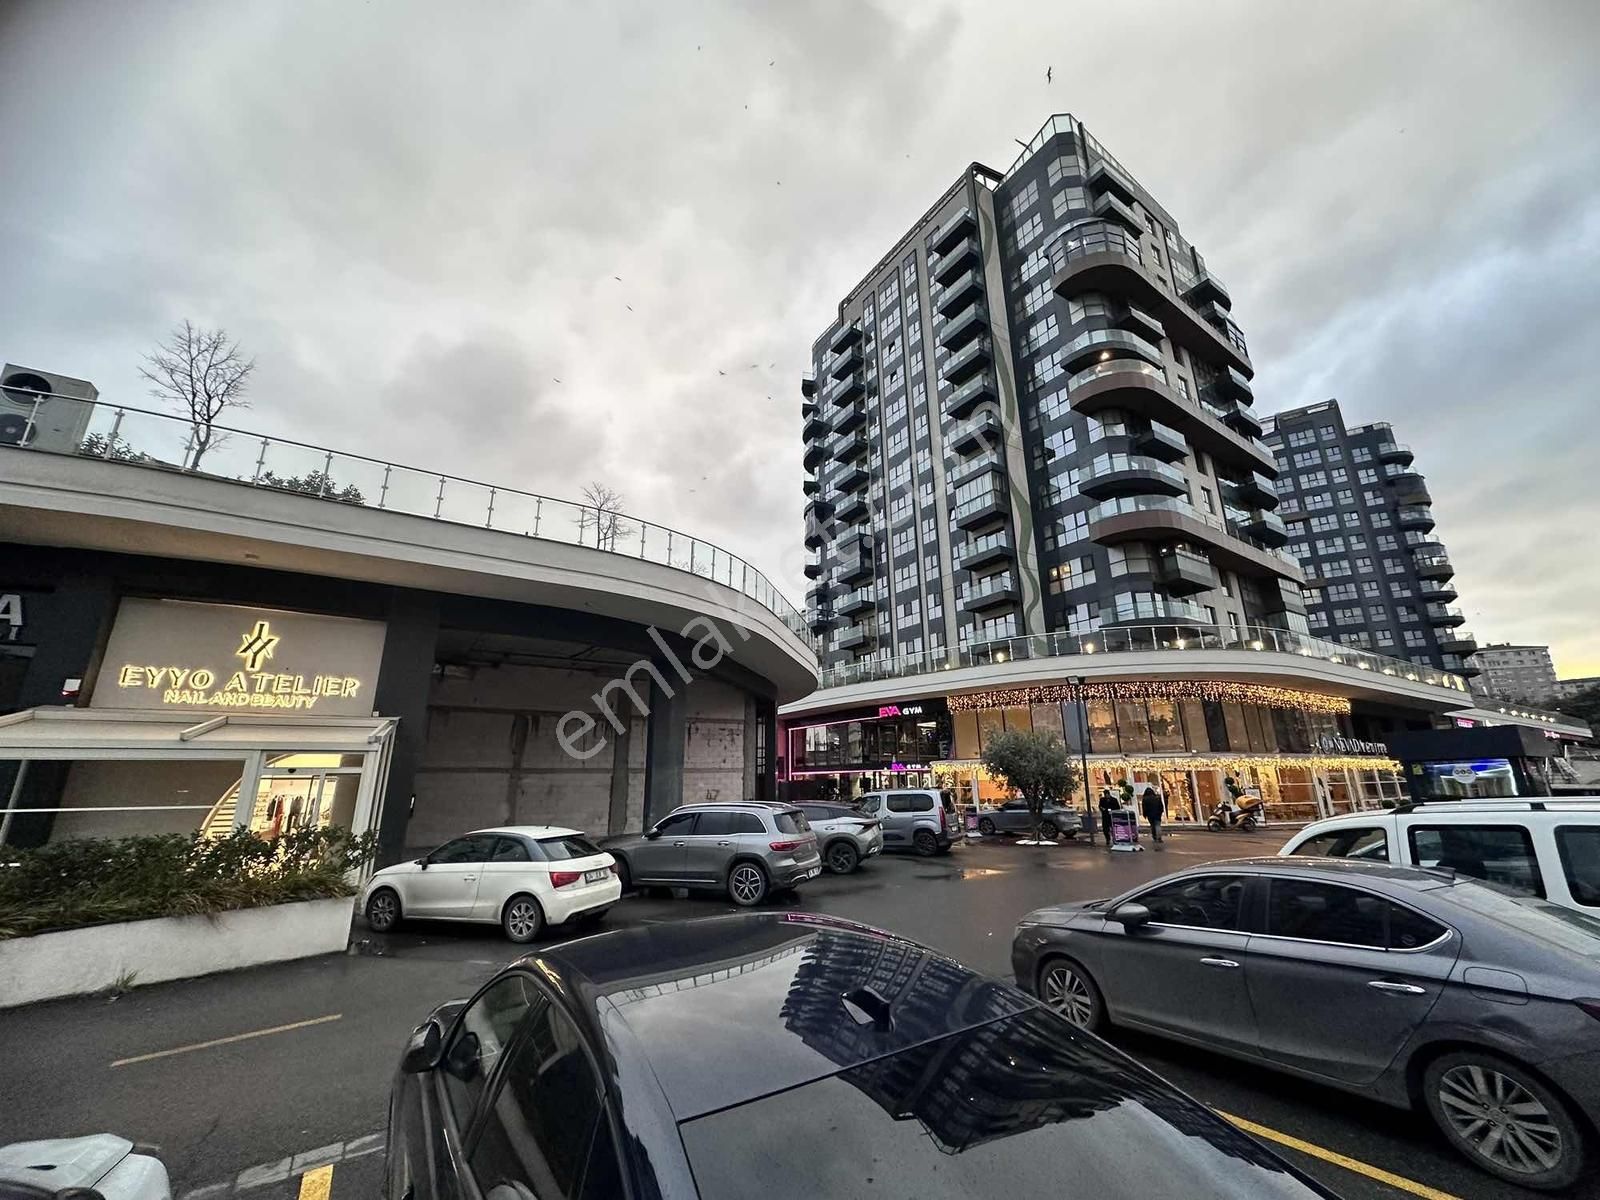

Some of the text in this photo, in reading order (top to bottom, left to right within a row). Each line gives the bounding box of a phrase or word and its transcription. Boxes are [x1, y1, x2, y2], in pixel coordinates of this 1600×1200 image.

[118, 664, 361, 698] EYYO ATELIER
[878, 705, 923, 717] EVA GYM
